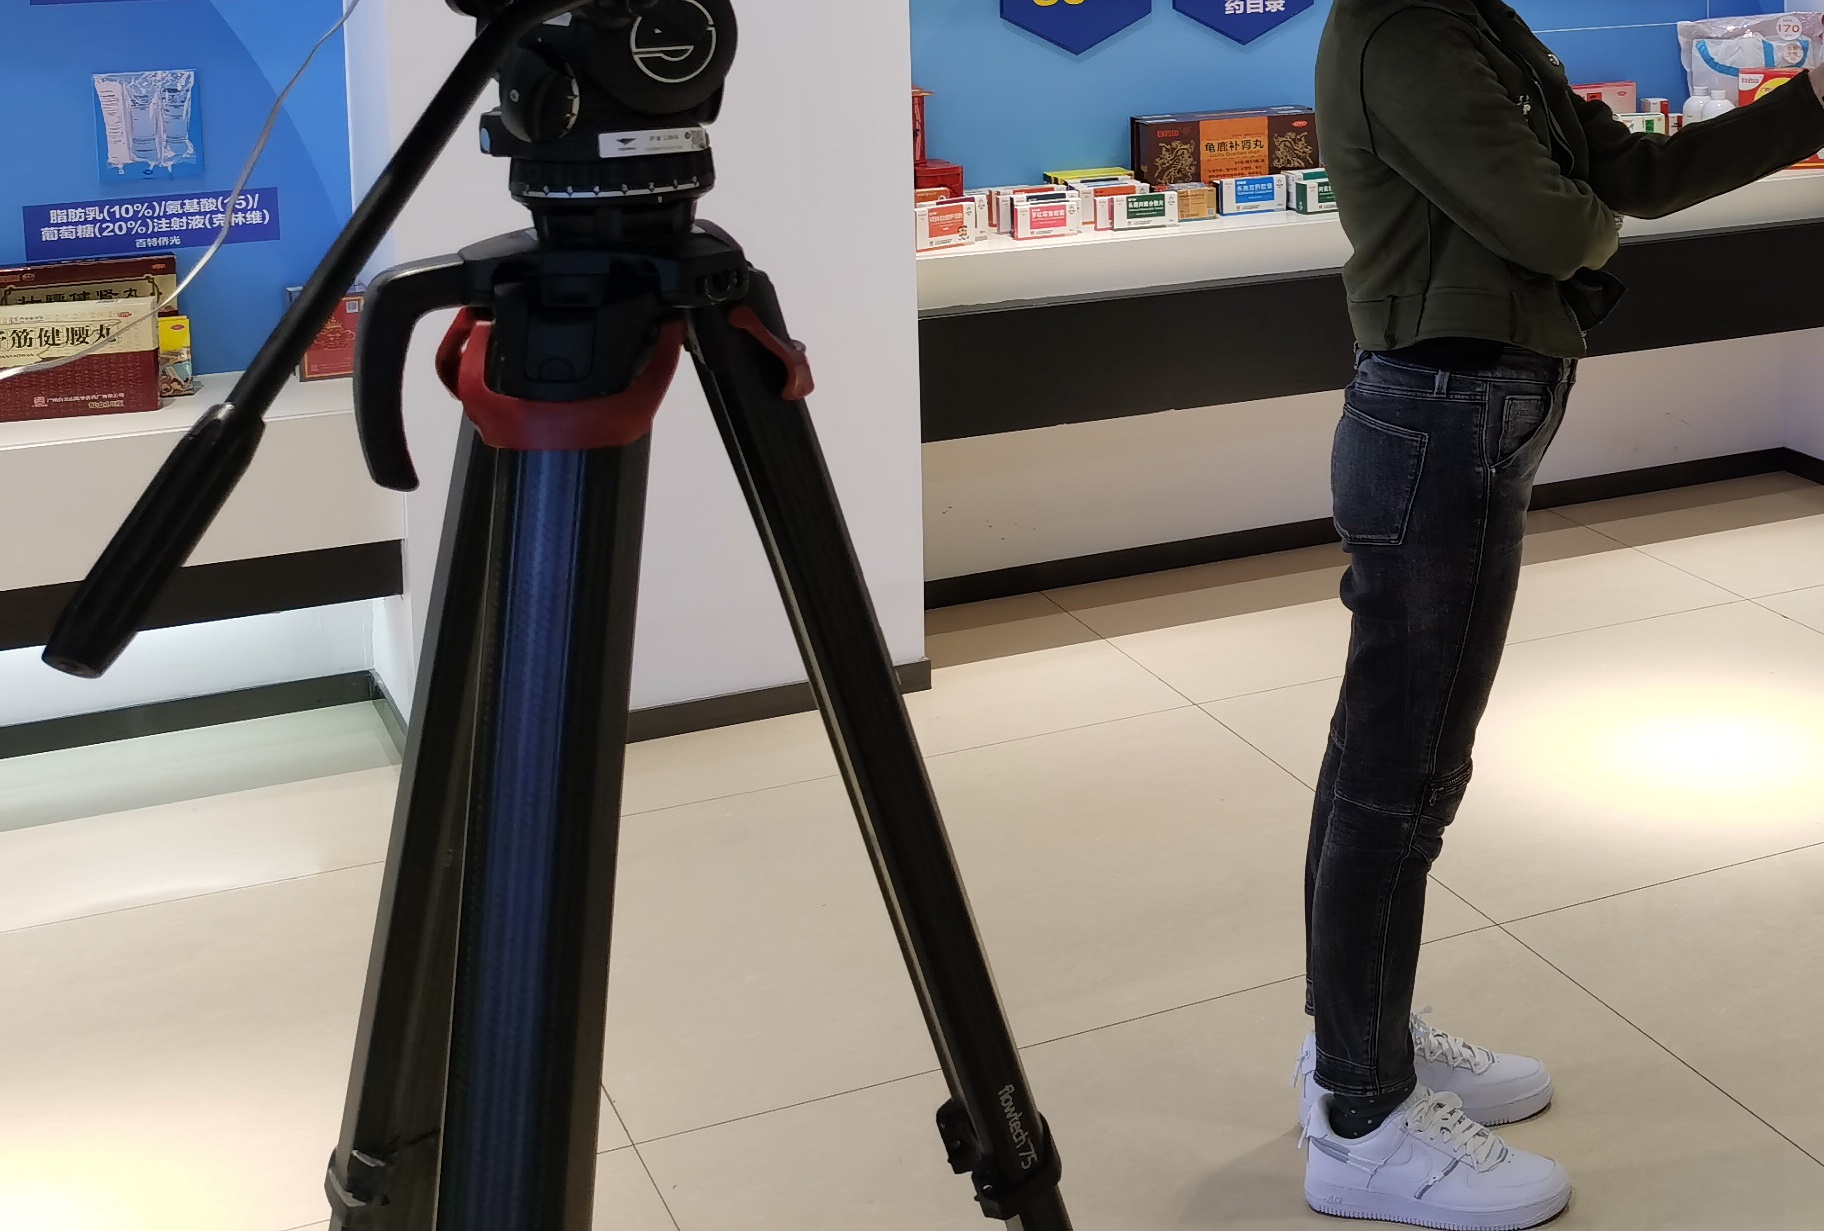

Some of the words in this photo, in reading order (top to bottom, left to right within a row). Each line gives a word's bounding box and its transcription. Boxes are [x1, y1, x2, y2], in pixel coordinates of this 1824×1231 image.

[1205, 139, 1264, 153] 龟鹿补肾丸
[135, 236, 181, 249] 百特侨光
